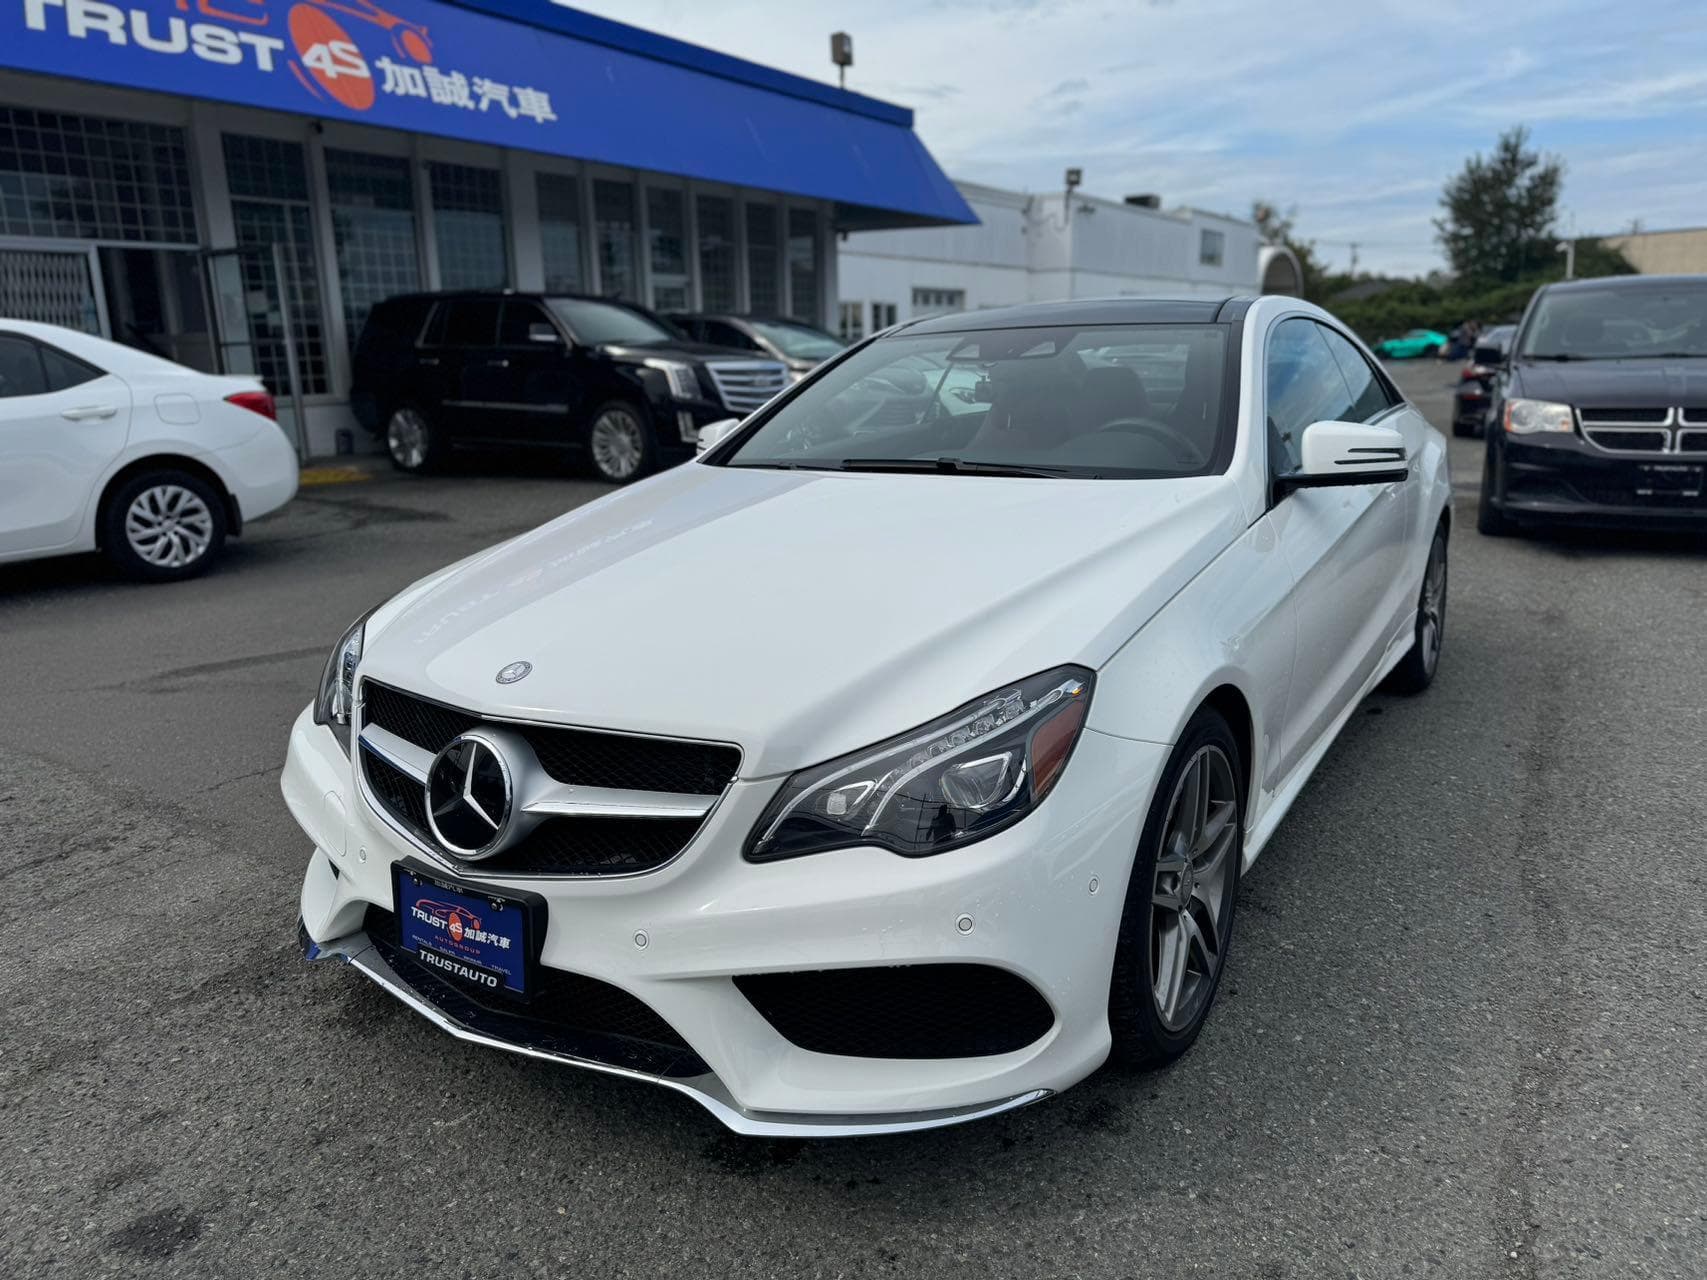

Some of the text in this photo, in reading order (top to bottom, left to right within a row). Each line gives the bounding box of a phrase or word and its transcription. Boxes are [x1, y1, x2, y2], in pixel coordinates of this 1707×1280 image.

[24, 0, 558, 123] TRUST 4S 加誠汽車
[411, 906, 448, 930] TRUST
[449, 922, 463, 933] 4S
[419, 949, 498, 987] TRUSTAUTO
